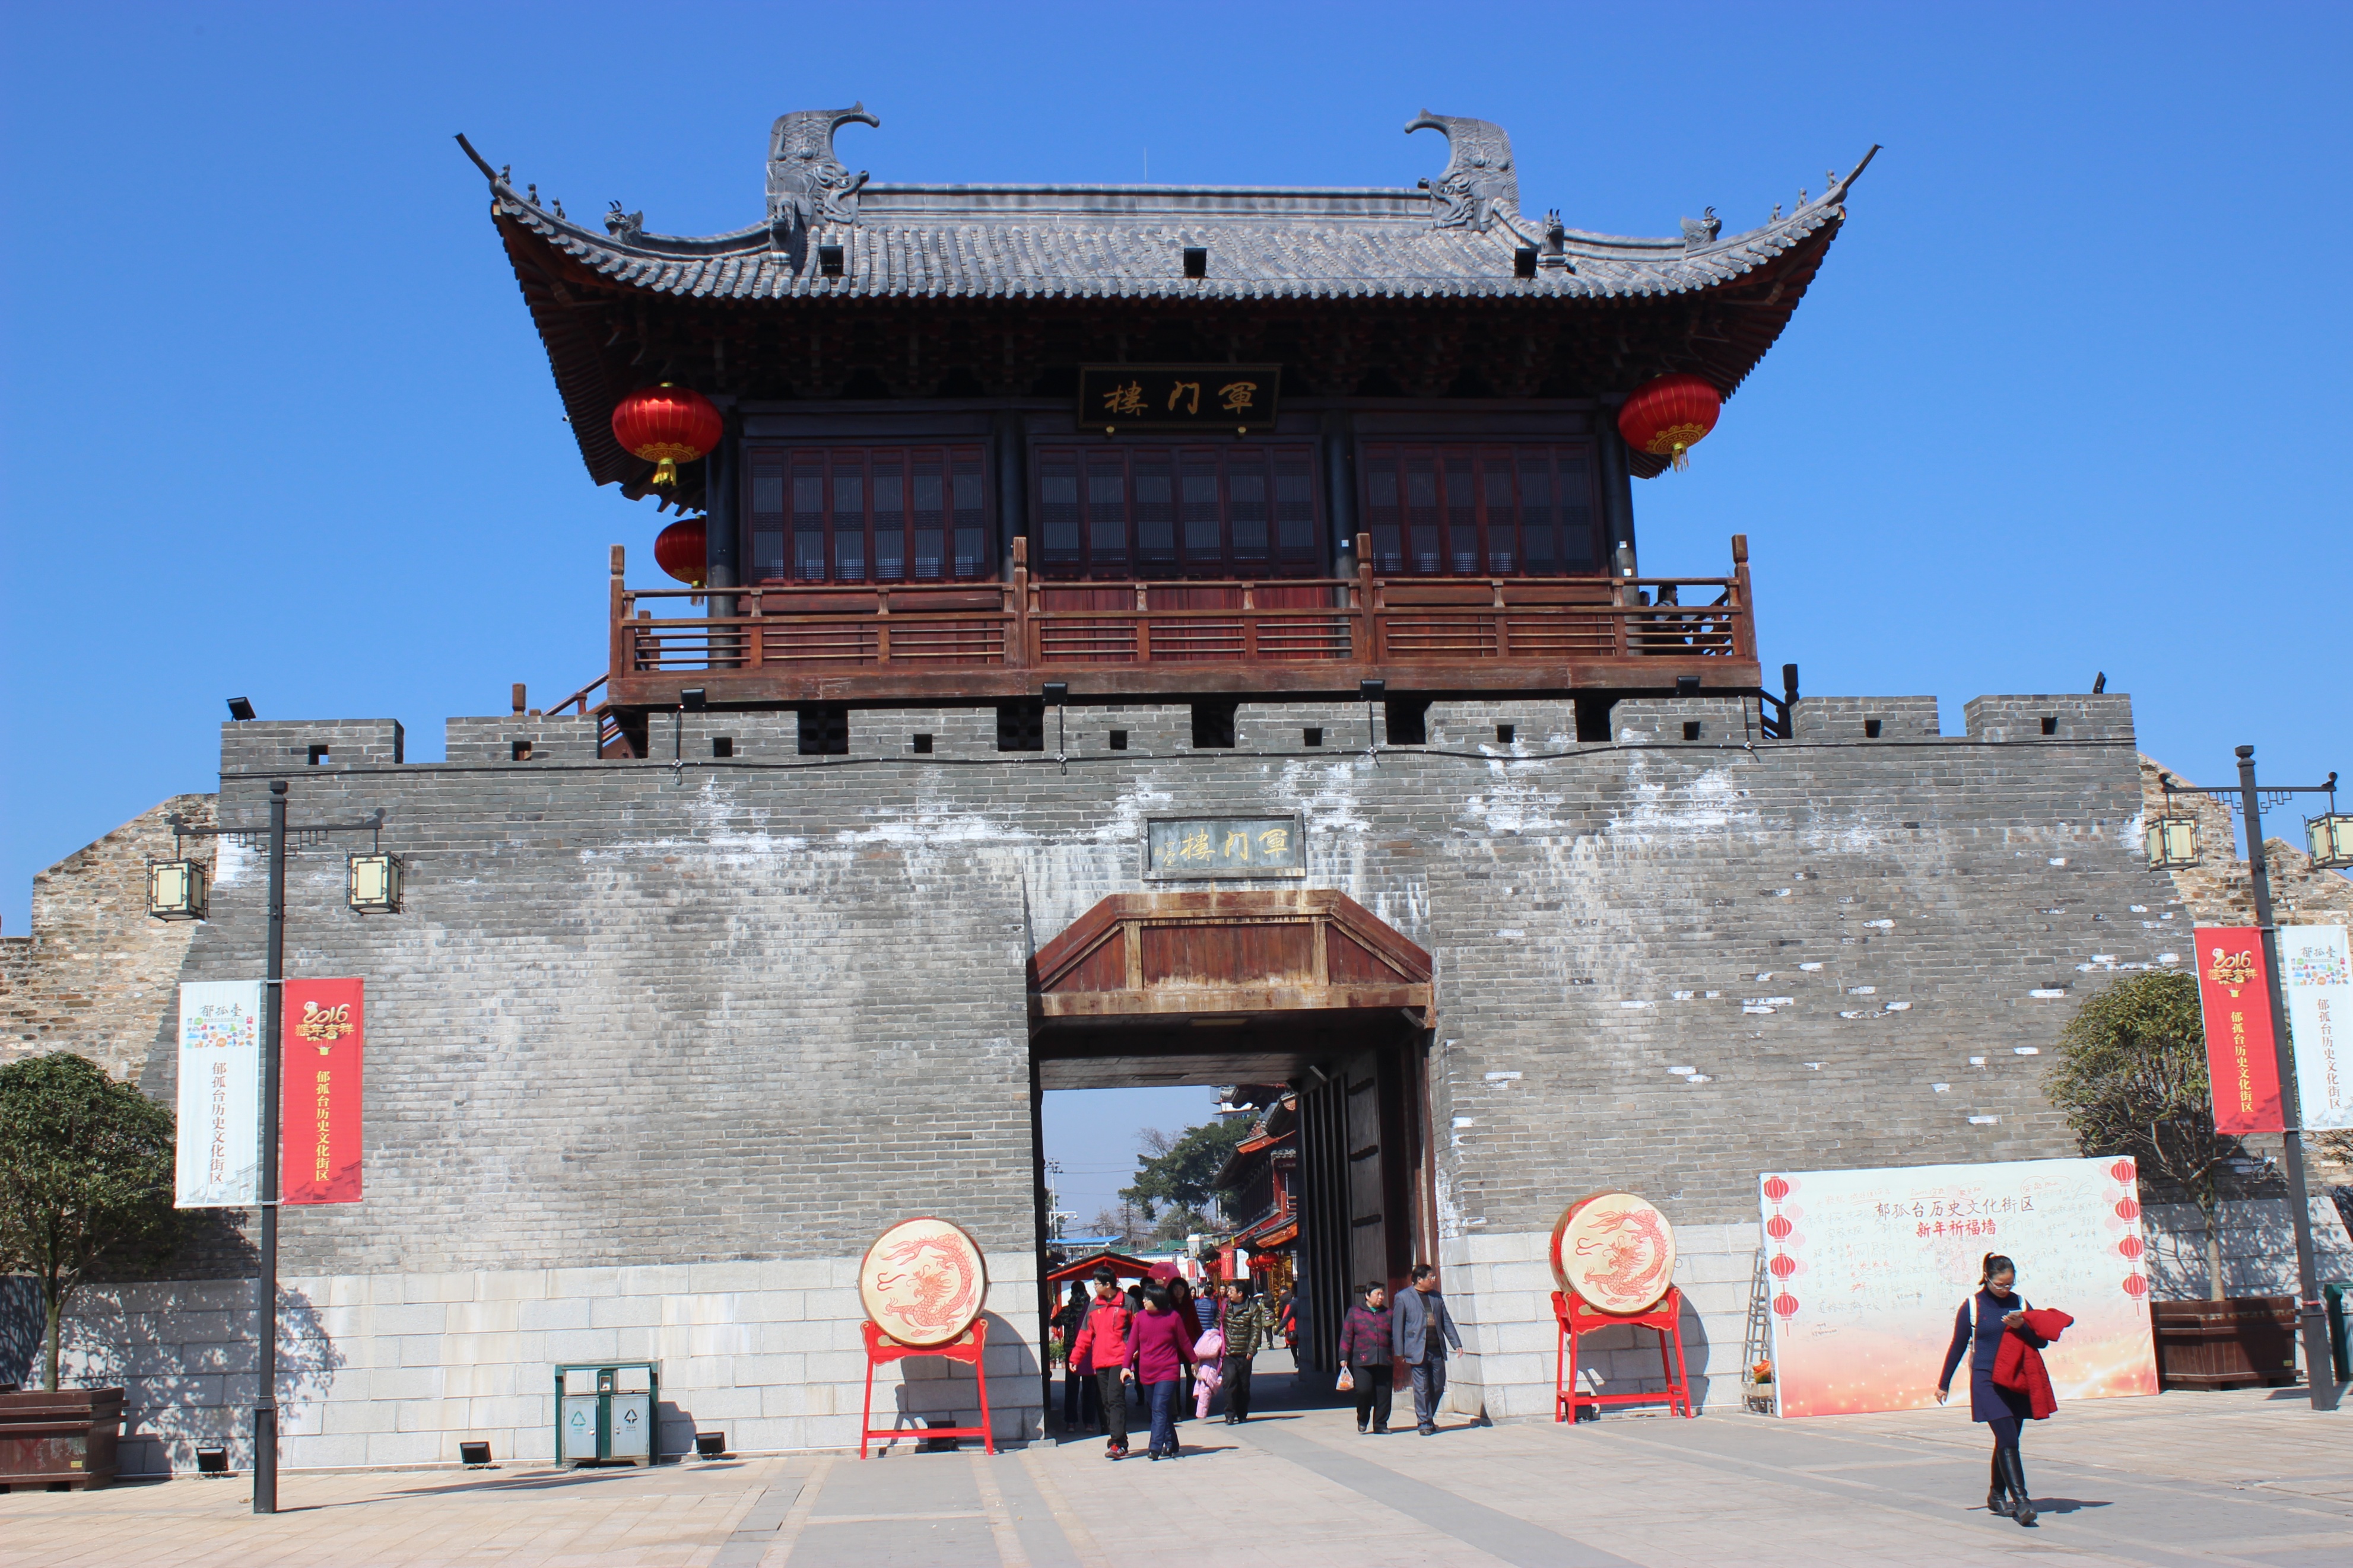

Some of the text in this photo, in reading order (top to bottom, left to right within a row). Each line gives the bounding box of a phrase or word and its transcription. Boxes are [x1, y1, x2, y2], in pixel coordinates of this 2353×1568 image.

[2212, 948, 2252, 969] 2016
[2207, 968, 2258, 984] 猴年吉祥
[303, 1001, 351, 1023] 2016
[295, 1023, 355, 1039] 猴年吉祥
[2231, 1011, 2253, 1112] 郁孤台历史文化街区
[2317, 998, 2342, 1109] 郁孤台历史文化街区
[209, 1061, 227, 1185] 郁孤台历史文化街区
[316, 1070, 331, 1181] 郁孤台历史文化街区
[1875, 1195, 2034, 1220] 郁孤台历史文化街区
[1916, 1218, 1997, 1238] 新年祈福墙
